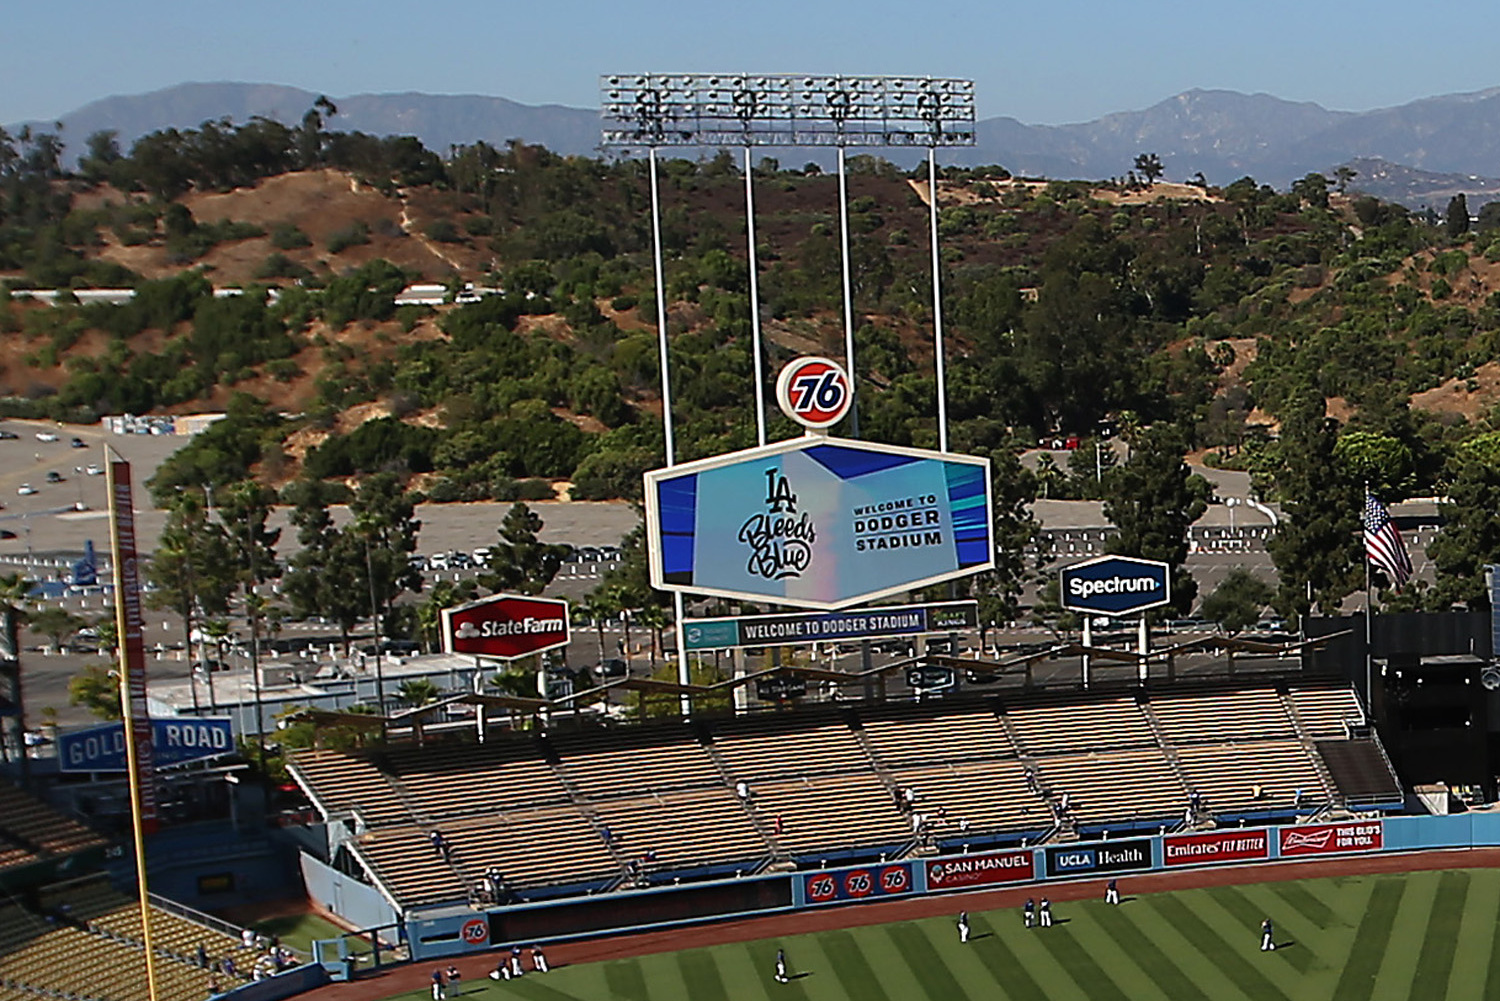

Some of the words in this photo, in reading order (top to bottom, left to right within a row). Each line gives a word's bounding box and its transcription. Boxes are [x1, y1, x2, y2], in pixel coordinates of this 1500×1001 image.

[792, 370, 845, 413] 76
[765, 467, 797, 514] LA
[854, 498, 913, 515] WELCOME
[920, 494, 936, 505] TO
[739, 512, 816, 550] Bleeds
[855, 510, 939, 533] DODGER
[856, 531, 942, 551] STADIUM
[748, 539, 812, 579] Blue
[1070, 576, 1155, 598] Spectrum
[746, 622, 802, 639] WELCOME
[805, 622, 819, 634] TO
[822, 617, 866, 633] DODGER
[870, 613, 920, 630] STADIUM
[166, 725, 226, 748] ROAD
[1060, 855, 1091, 866] UCLA
[1099, 849, 1143, 864] Health
[1167, 842, 1218, 857] Emirates
[945, 862, 972, 874] SAN
[975, 856, 1029, 870] MANUEL
[812, 878, 834, 895] 76
[848, 874, 870, 892] 76
[883, 870, 906, 887] 76
[466, 923, 486, 940] 76
